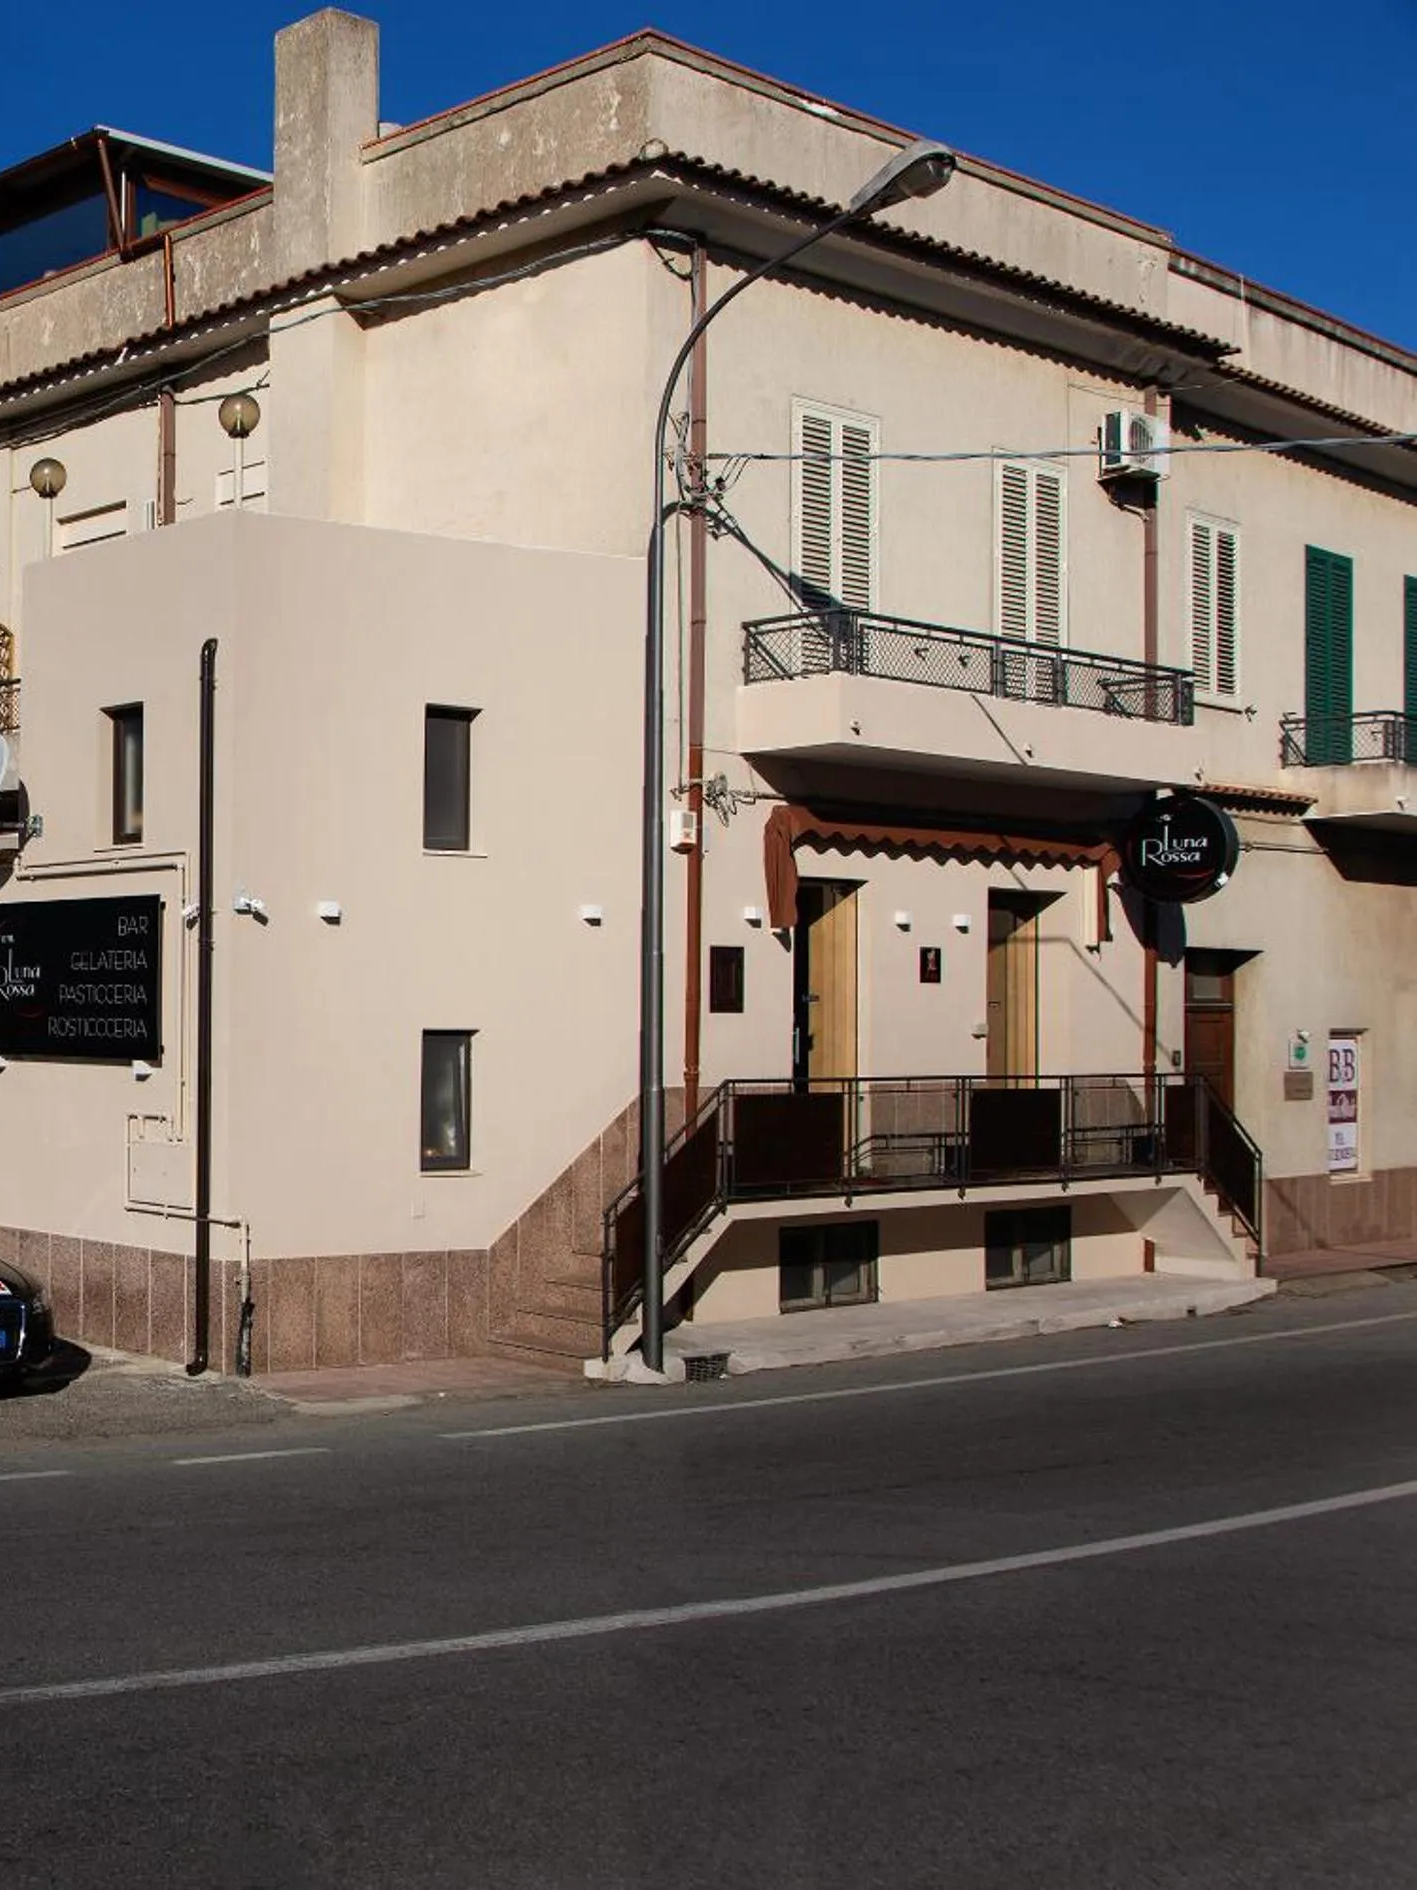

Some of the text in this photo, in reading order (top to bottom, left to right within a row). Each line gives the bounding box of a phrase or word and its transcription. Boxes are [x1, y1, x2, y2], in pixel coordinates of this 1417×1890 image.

[1164, 825, 1208, 851] Luna
[1142, 839, 1200, 867] Rossa
[118, 916, 149, 936] BAR
[8, 948, 41, 983] Luna
[70, 949, 148, 971] GELATERIA
